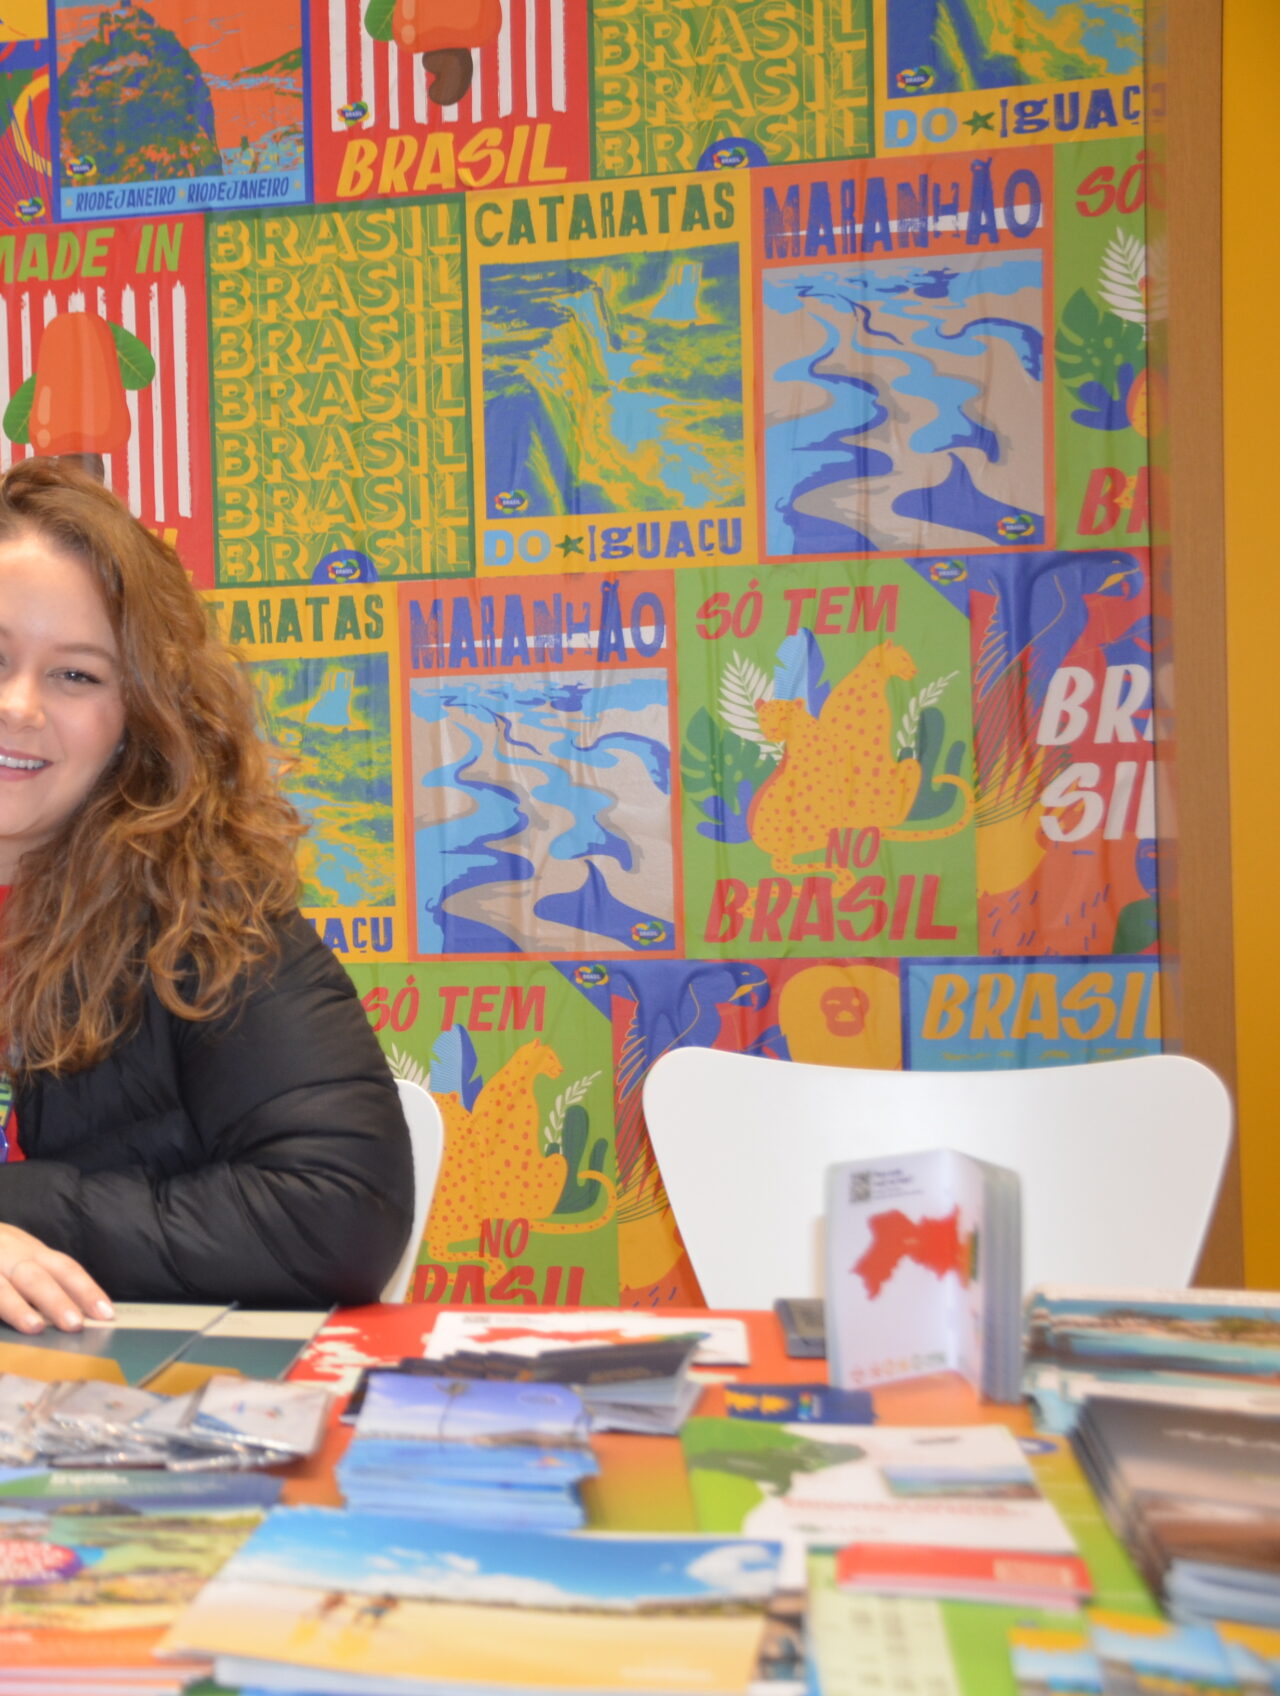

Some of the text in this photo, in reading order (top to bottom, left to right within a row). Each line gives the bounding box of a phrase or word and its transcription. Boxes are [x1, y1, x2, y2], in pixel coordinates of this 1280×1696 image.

[595, 51, 868, 131] BRASIL
[335, 123, 568, 198] BRASIL
[883, 107, 958, 148] DO
[209, 204, 462, 272] BRASIL
[473, 182, 736, 248] CATARATAS
[763, 156, 1043, 259] MARANHÃO
[135, 223, 184, 273] IN
[211, 256, 463, 326] BRASIL
[214, 310, 464, 379] BRASIL
[215, 362, 466, 432] BRASIL
[217, 417, 467, 486] BRASIL
[219, 472, 469, 539] BRASIL
[483, 529, 551, 566] DO
[408, 580, 666, 669] MARANHÃO
[695, 578, 899, 640] SÓ TEM
[1037, 664, 1155, 747] BR
[825, 825, 880, 869] NO
[703, 875, 958, 943] BRASIL
[360, 975, 545, 1032] SÓ TEM
[478, 1218, 530, 1259] NO
